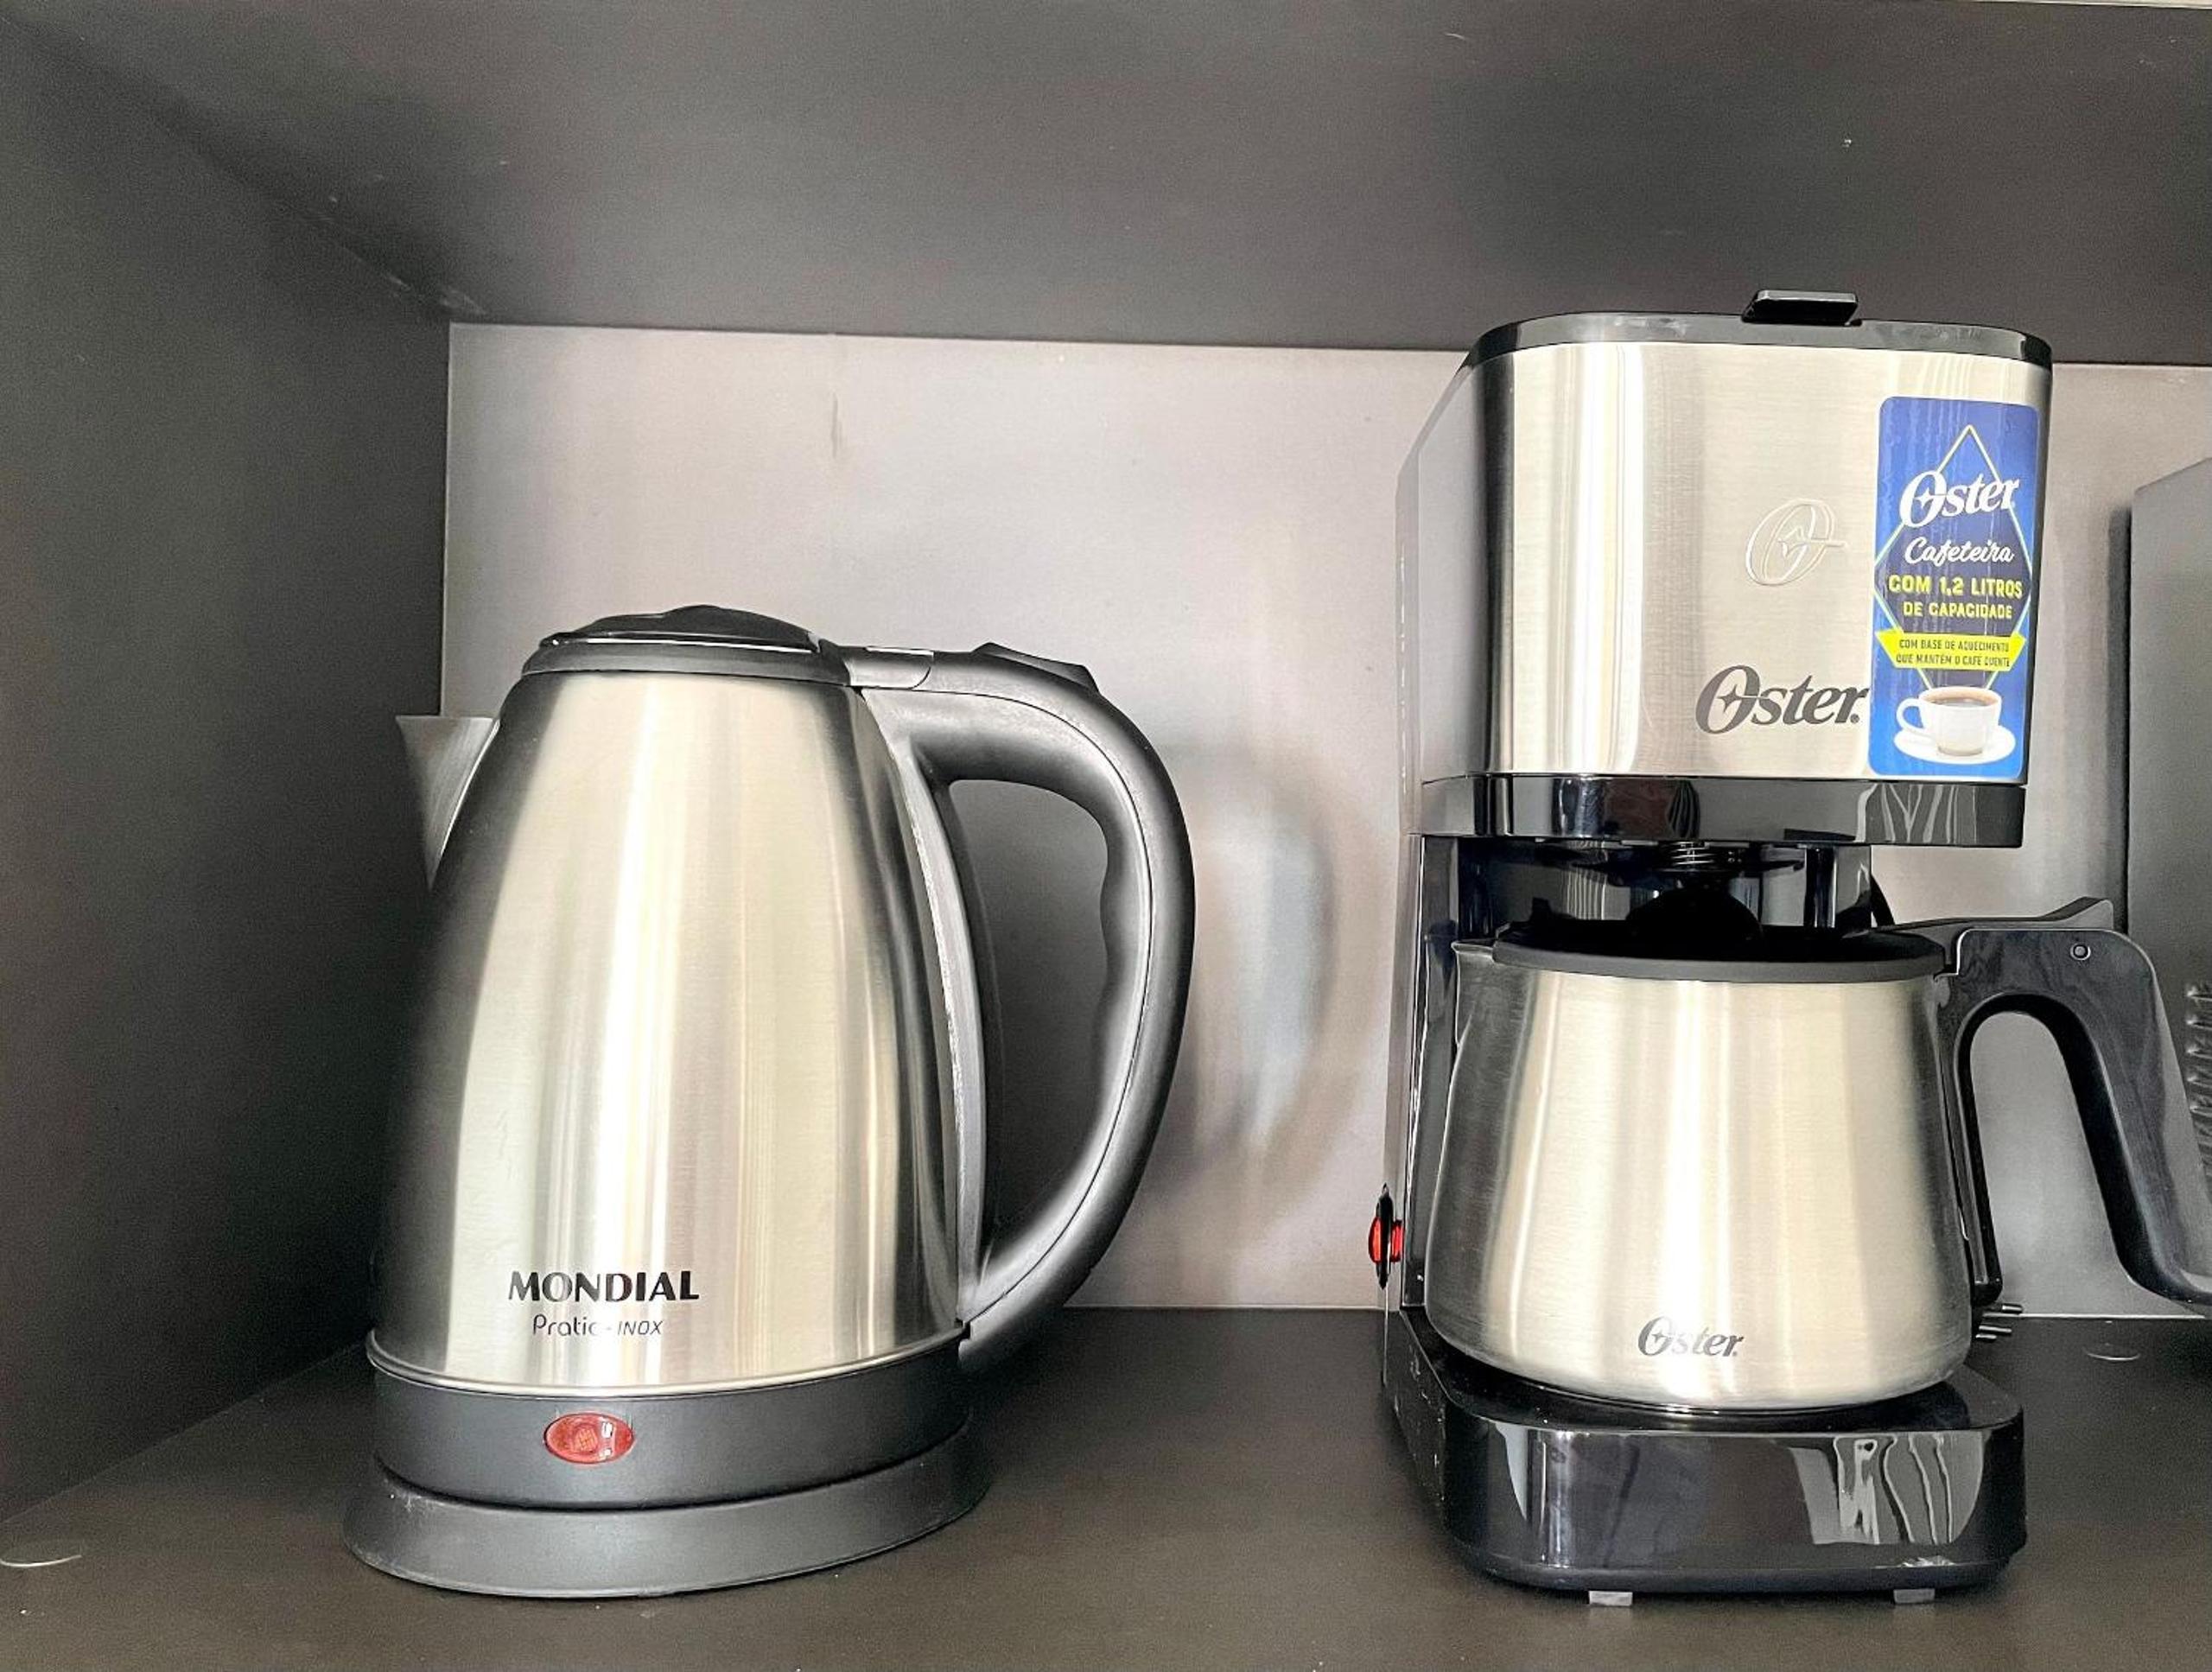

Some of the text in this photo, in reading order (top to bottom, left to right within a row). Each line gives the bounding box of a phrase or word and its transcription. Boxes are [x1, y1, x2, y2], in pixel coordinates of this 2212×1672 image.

[1899, 470, 2020, 528] Oster
[1904, 537, 2015, 567] Cafeteira
[1888, 574, 1931, 595] COM
[1971, 577, 2024, 599] LITROS
[1903, 601, 2013, 620] DE CAPACIDADE
[1896, 653, 1914, 664] QUE
[1899, 639, 2010, 652] COM BASE DE AQUECIMENTO
[1694, 664, 1870, 734] Oster
[508, 1270, 700, 1302] MONDIAL
[532, 1313, 597, 1337] Pratic
[617, 1320, 664, 1336] INOX
[1637, 1316, 1745, 1357] Oster
